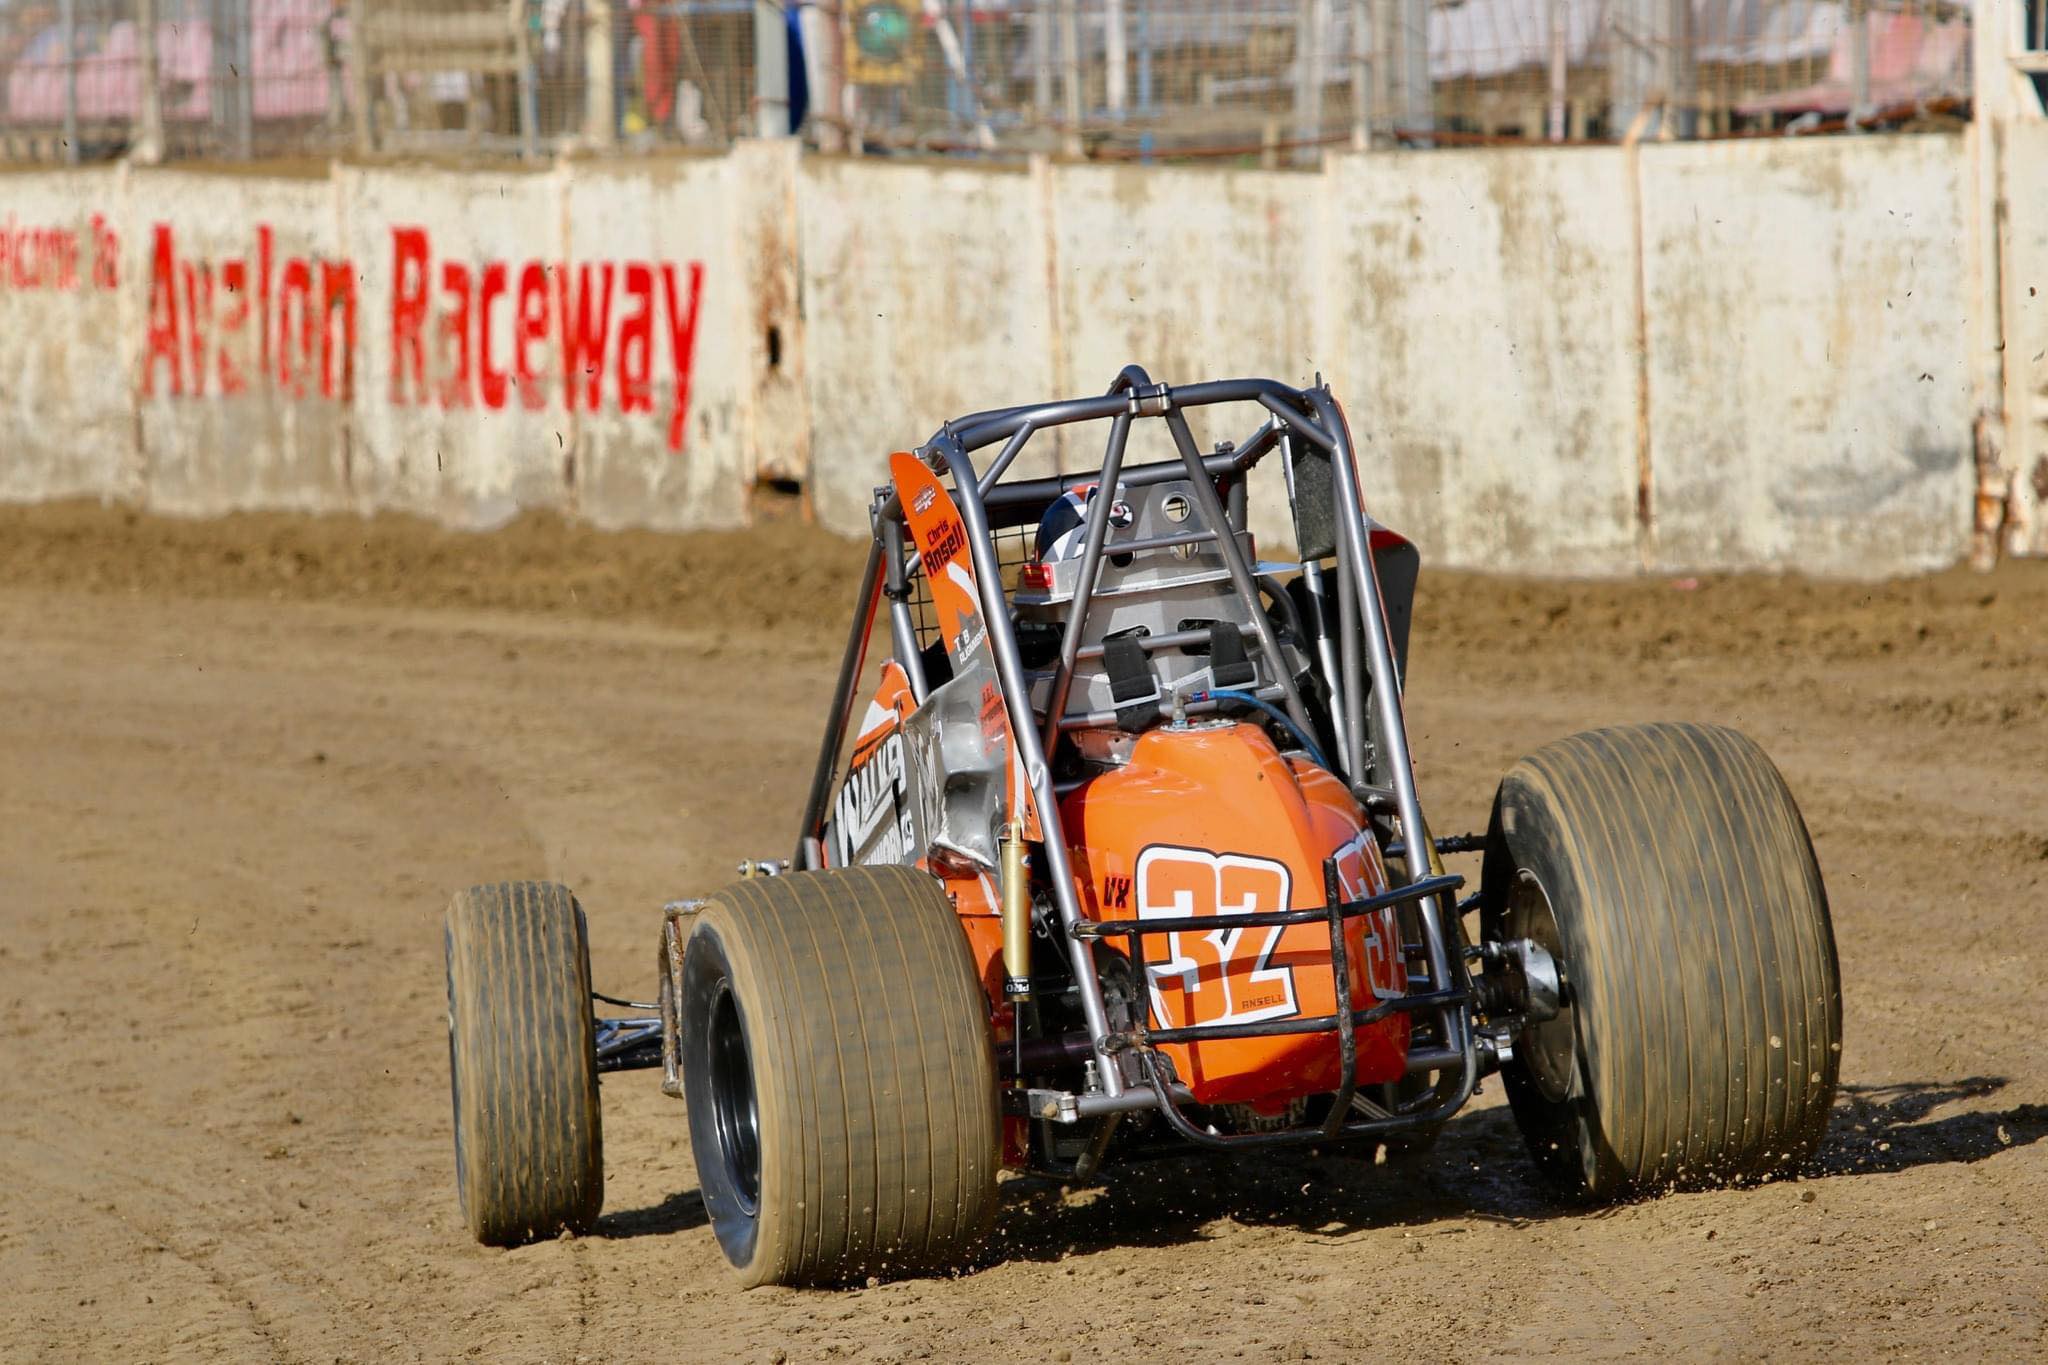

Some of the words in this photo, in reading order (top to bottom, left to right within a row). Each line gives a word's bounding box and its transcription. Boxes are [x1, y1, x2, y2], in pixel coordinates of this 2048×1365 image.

[145, 222, 356, 398] Avalon
[390, 222, 705, 452] Raceway
[927, 519, 949, 545] Chris
[1103, 876, 1131, 909] VX
[1136, 843, 1301, 1029] 32
[1241, 993, 1284, 1009] ANSELL
